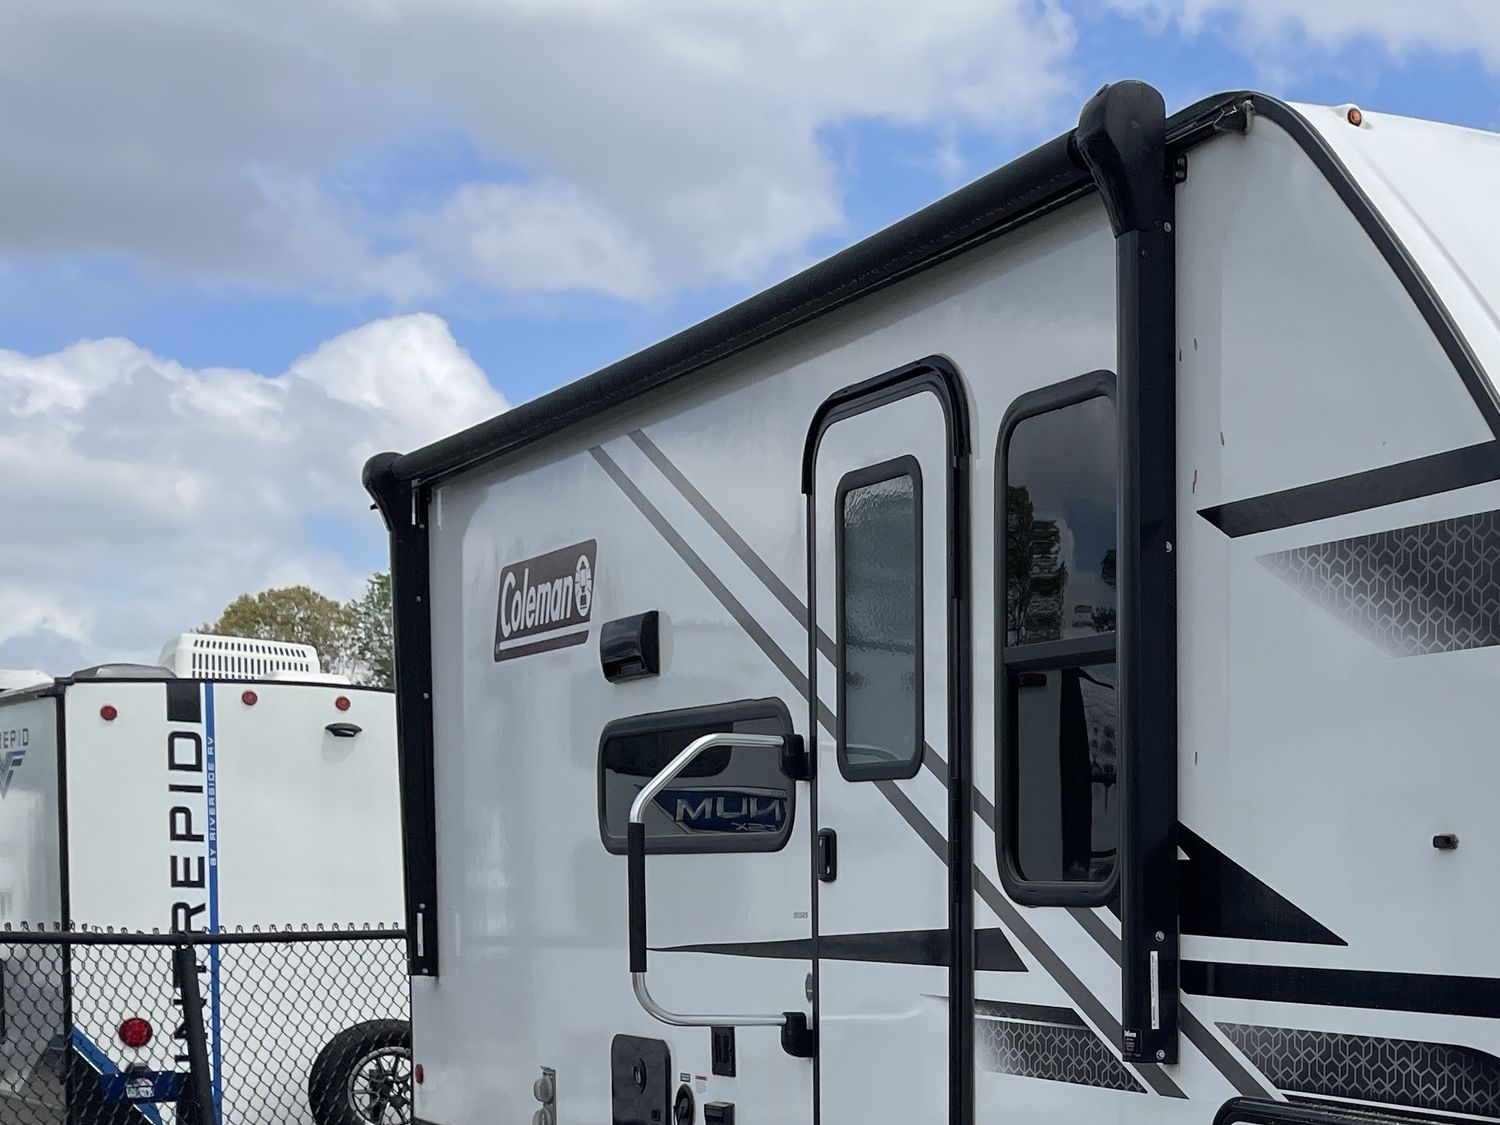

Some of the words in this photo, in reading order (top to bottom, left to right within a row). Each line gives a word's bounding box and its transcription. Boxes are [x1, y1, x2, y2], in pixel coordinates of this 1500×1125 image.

[500, 567, 574, 638] Coleman
[0, 728, 29, 749] EPID
[207, 736, 215, 755] RV
[207, 762, 217, 841] RIVERSIDE
[209, 849, 217, 866] BY
